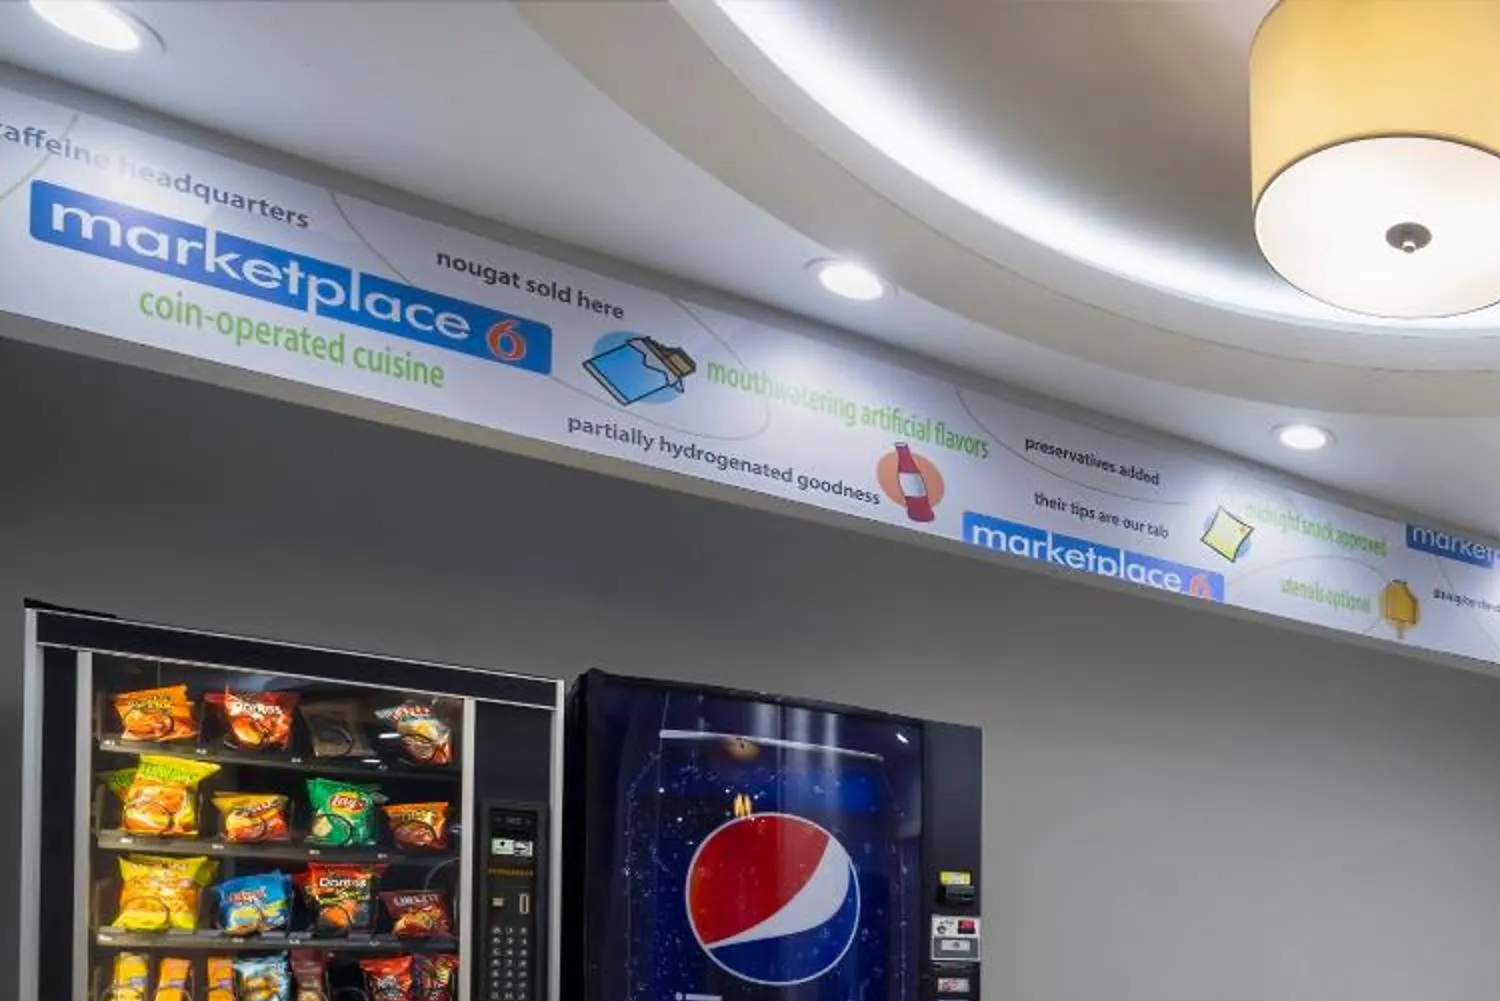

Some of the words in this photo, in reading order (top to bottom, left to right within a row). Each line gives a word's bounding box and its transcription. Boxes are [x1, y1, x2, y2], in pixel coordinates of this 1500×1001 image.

[117, 151, 311, 229] headquarters
[51, 202, 470, 339] marketplace
[485, 319, 528, 361] 6
[436, 249, 520, 290] nougat
[525, 275, 573, 306] sold
[577, 290, 625, 321] here
[139, 287, 345, 364] coin-operated
[352, 345, 445, 388] cuisine
[707, 359, 857, 427] mouthwatering
[860, 405, 931, 442] artificial
[934, 424, 991, 460] flavors
[567, 414, 655, 452] partially
[659, 434, 793, 484] hydrogenated
[797, 470, 881, 506] goodness
[1025, 437, 1116, 473] preservatives
[1119, 464, 1160, 485] added
[1034, 491, 1067, 512] their
[1069, 501, 1096, 521] tips
[1099, 510, 1120, 525] are
[1122, 515, 1146, 532] our
[1147, 521, 1170, 539] tab
[972, 524, 1184, 592] marketplace
